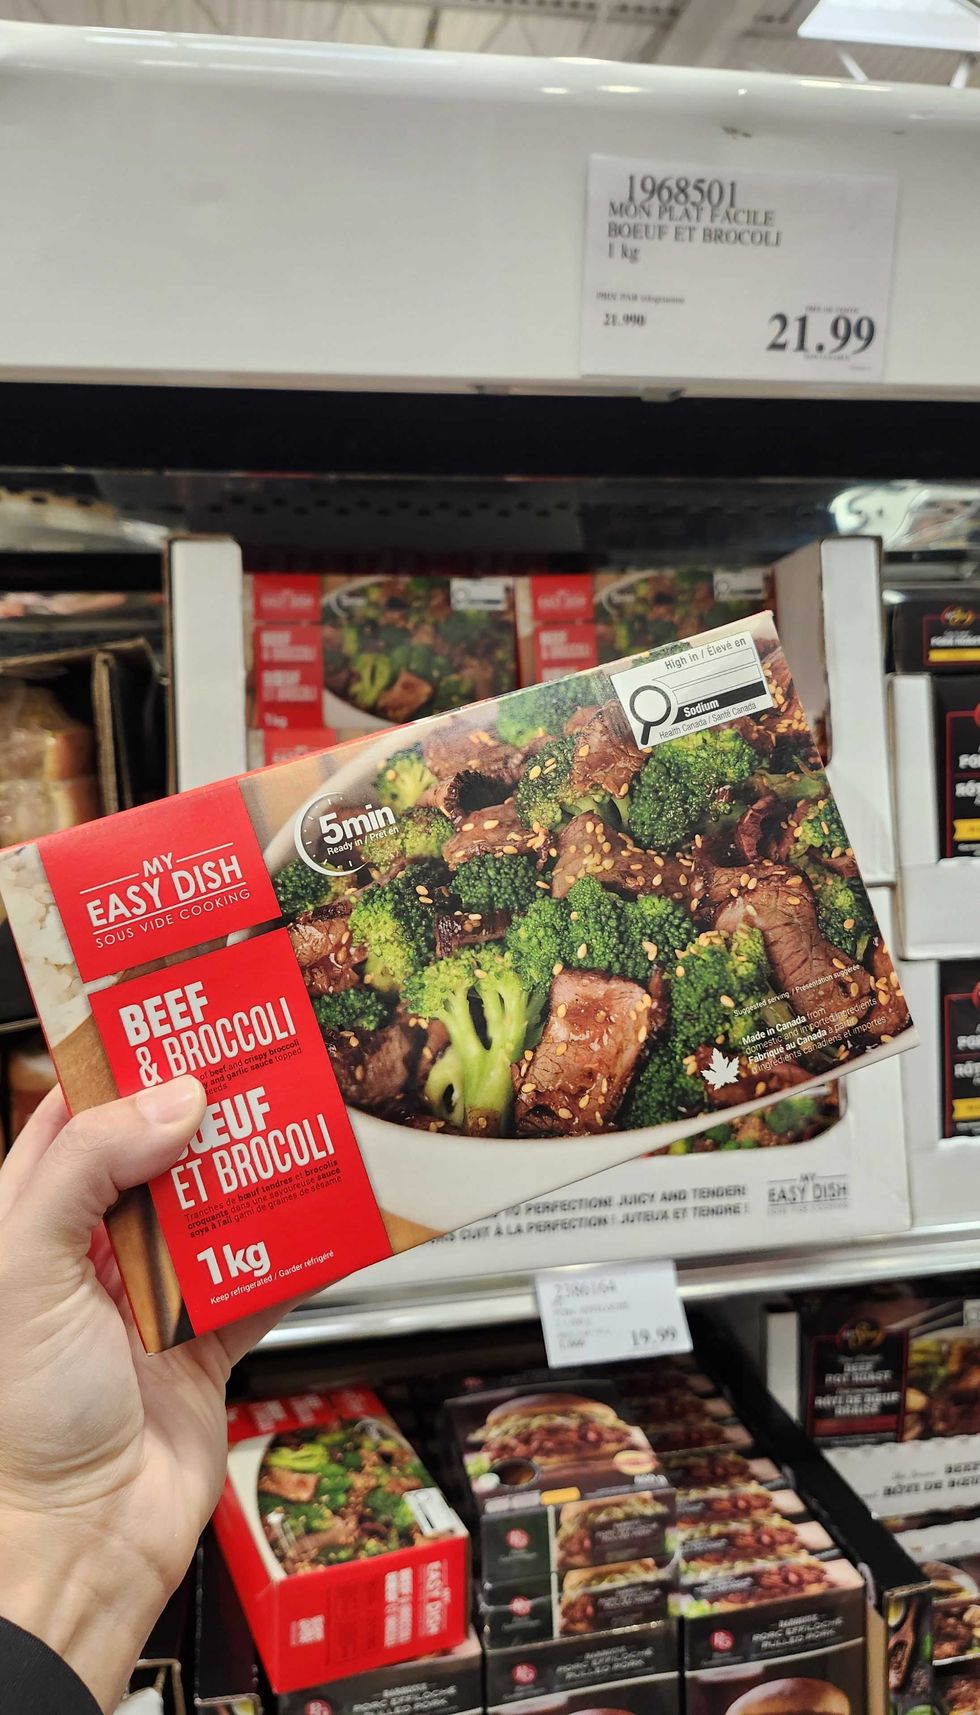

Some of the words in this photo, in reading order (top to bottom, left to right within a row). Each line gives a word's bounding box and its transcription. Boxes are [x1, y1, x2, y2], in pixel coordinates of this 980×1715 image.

[627, 174, 738, 208] 1968501
[608, 201, 651, 219] MON
[658, 203, 703, 223] PLAT
[710, 206, 775, 227] FACILE
[608, 221, 668, 241] BOEUF
[674, 225, 696, 243] ET
[702, 227, 782, 247] BROCOLI
[620, 244, 640, 264] kg
[766, 312, 876, 355] 21.99
[664, 656, 688, 670] High
[689, 651, 699, 662] in
[707, 640, 733, 657] Élevé
[734, 636, 747, 647] en
[659, 728, 682, 740] Health
[681, 717, 707, 732] Canada
[711, 709, 732, 723] Santé
[732, 702, 757, 716] Canada
[683, 699, 720, 718] Sodium
[318, 804, 396, 845] 5min
[327, 841, 353, 856] Ready
[354, 838, 363, 847] in
[369, 830, 387, 841] Prêt
[388, 826, 400, 835] en
[143, 852, 173, 878] MY
[86, 877, 162, 928] EASY
[171, 855, 243, 902] DISH
[95, 927, 135, 949] SOUS
[139, 914, 175, 933] VIDE
[179, 888, 251, 920] COOKING
[118, 981, 208, 1047] BEEF
[733, 1001, 767, 1017] Suggested
[767, 991, 790, 1005] serving
[135, 1046, 164, 1088] &
[161, 997, 297, 1078] BROCCOLI
[742, 1031, 766, 1046] Made
[767, 1027, 776, 1037] in
[775, 1015, 807, 1032] Canada
[806, 1007, 827, 1020] from
[745, 1036, 783, 1055] domestic
[783, 1028, 800, 1040] and
[799, 1012, 835, 1034] imported
[835, 998, 877, 1018] ingredients
[802, 1034, 843, 1055] canadiens
[843, 1030, 852, 1039] et
[852, 1015, 887, 1035] importés
[199, 1071, 208, 1081] of
[209, 1064, 227, 1077] beef
[228, 1058, 243, 1070] and
[244, 1052, 267, 1065] crispy
[268, 1039, 300, 1056] broccoli
[748, 1045, 785, 1065] Fabriqué
[785, 1041, 796, 1051] au
[796, 1029, 828, 1046] Canada
[210, 1076, 225, 1086] and
[226, 1066, 249, 1081] garlic
[250, 1059, 274, 1071] sauce
[275, 1048, 302, 1063] topped
[176, 1086, 271, 1161] ŒUF
[170, 1159, 208, 1210] ET
[212, 1113, 335, 1195] BROCOLI
[184, 1202, 224, 1223] Tranches
[225, 1196, 236, 1207] de
[237, 1186, 261, 1201] bœuf
[261, 1176, 293, 1193] tendres
[294, 1172, 303, 1181] et
[304, 1159, 338, 1177] brocolis
[187, 1209, 229, 1230] croquants
[230, 1201, 251, 1215] dans
[252, 1195, 268, 1206] une
[269, 1178, 316, 1199] savoureuse
[316, 1167, 341, 1181] sauce
[190, 1227, 210, 1239] soya
[211, 1222, 217, 1231] à
[234, 1209, 255, 1223] garni
[256, 1203, 267, 1214] de
[267, 1193, 298, 1210] graines
[299, 1186, 310, 1197] de
[310, 1175, 342, 1192] sésame
[619, 1192, 655, 1206] JUICY
[660, 1189, 686, 1203] AND
[768, 1184, 806, 1203] EASY
[812, 1181, 848, 1199] DISH
[526, 1213, 607, 1233] PERFECTION
[621, 1208, 668, 1224] JUTEUX
[673, 1206, 688, 1220] ET
[692, 1202, 741, 1218] TENDRE
[210, 1292, 230, 1305] Keep
[230, 1275, 273, 1297] refrigerated
[278, 1264, 304, 1278] Garder
[304, 1249, 334, 1268] réfrigéré
[631, 1325, 678, 1346] 19.99
